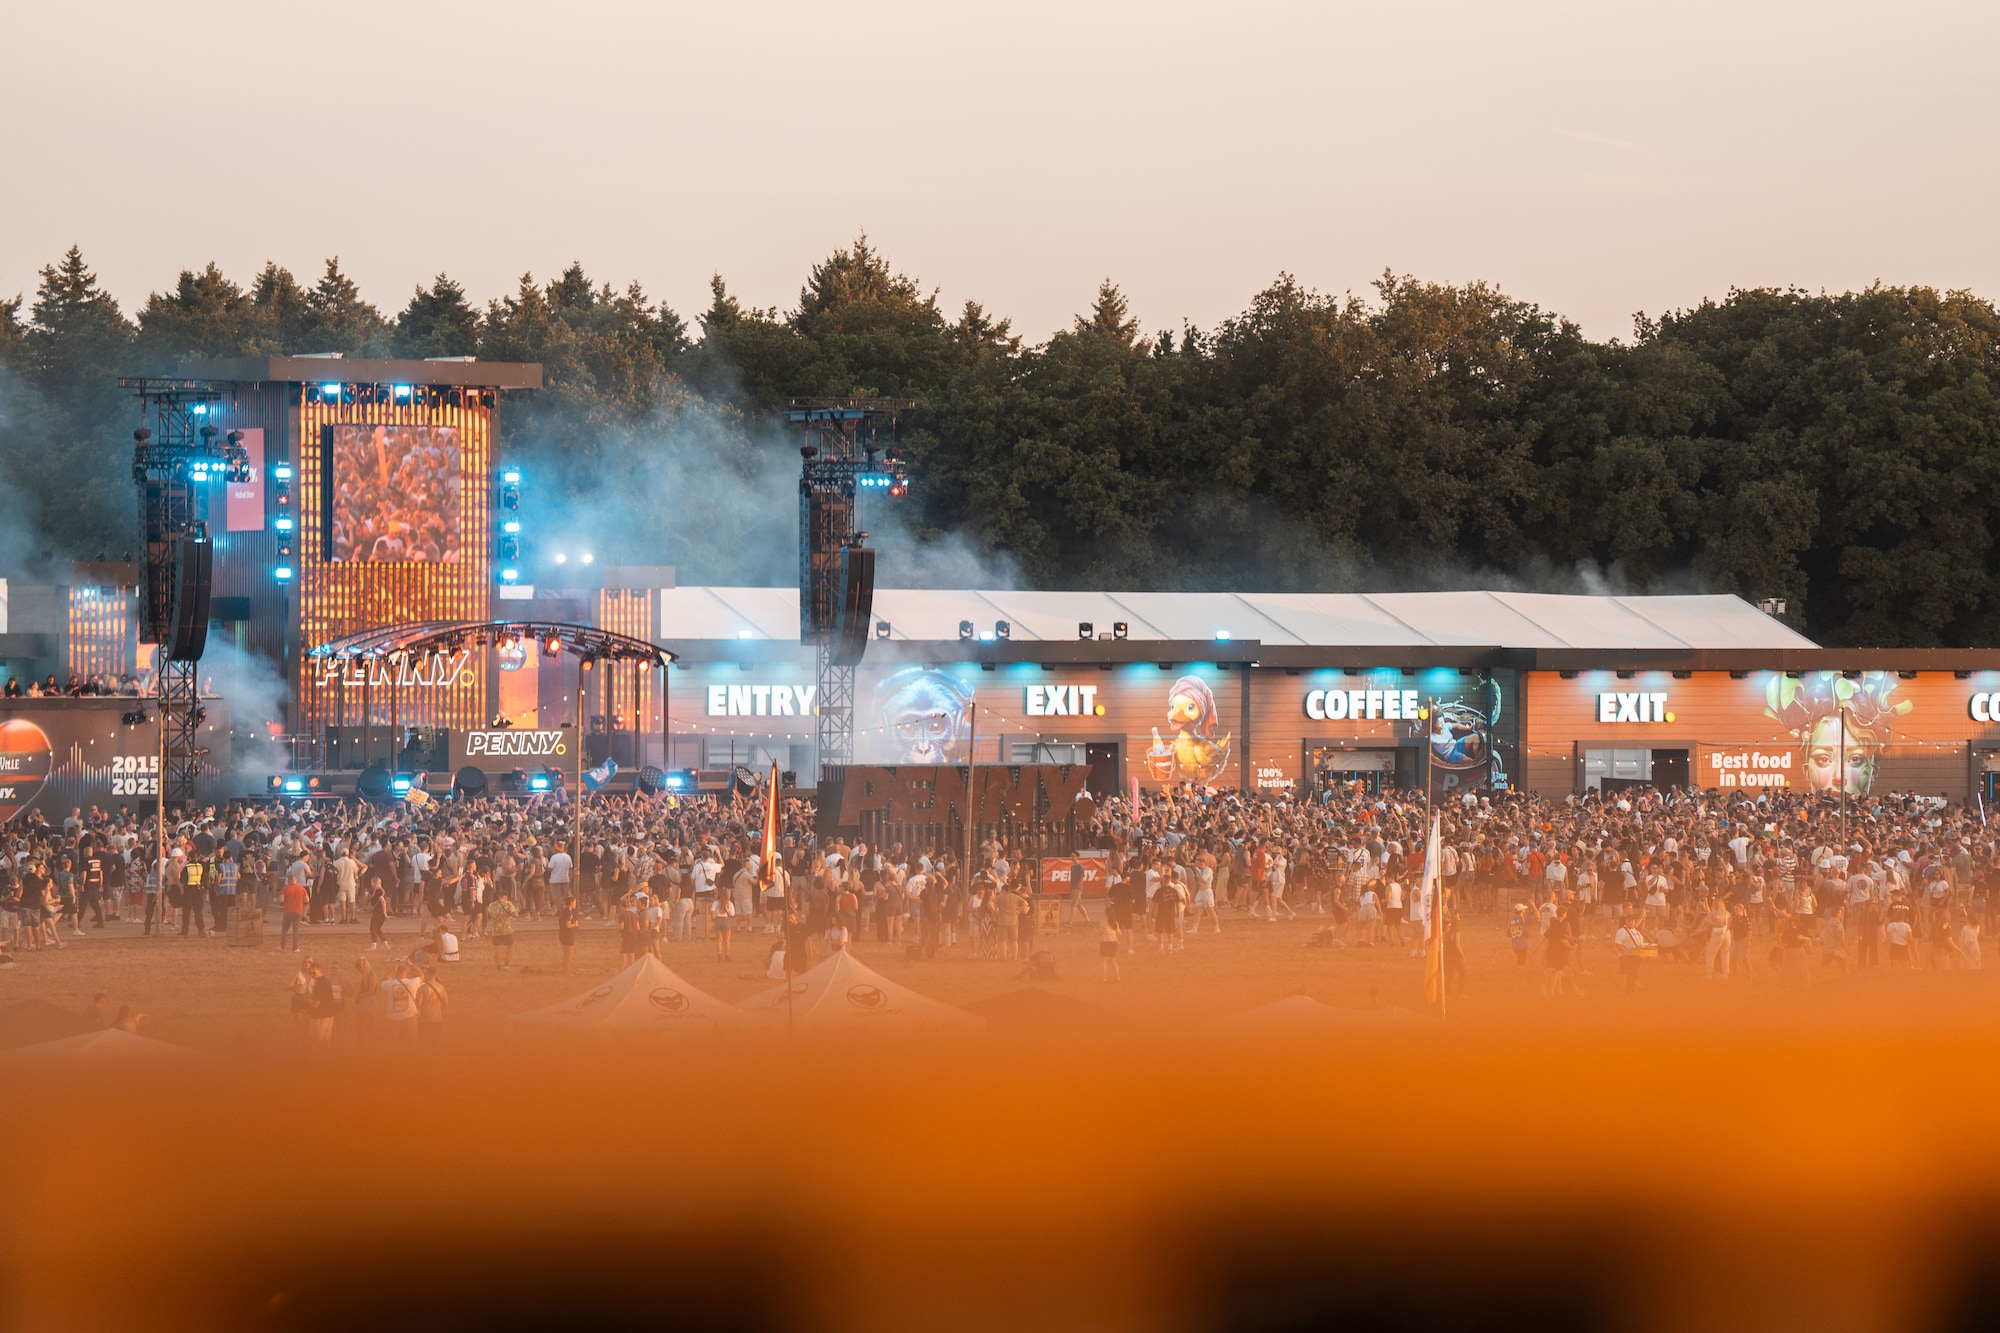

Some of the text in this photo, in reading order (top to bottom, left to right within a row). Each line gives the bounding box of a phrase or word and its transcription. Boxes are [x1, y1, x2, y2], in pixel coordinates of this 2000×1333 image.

[1026, 685, 1106, 716] EXIT.
[1306, 689, 1429, 720] COFFEE.
[1599, 692, 1676, 723] EXIT.
[466, 731, 566, 756] PENNY.
[112, 755, 159, 774] 2015
[1712, 751, 1792, 768] Best food
[1257, 768, 1283, 778] 100%
[1720, 768, 1791, 787] in town.
[112, 777, 158, 796] 2025
